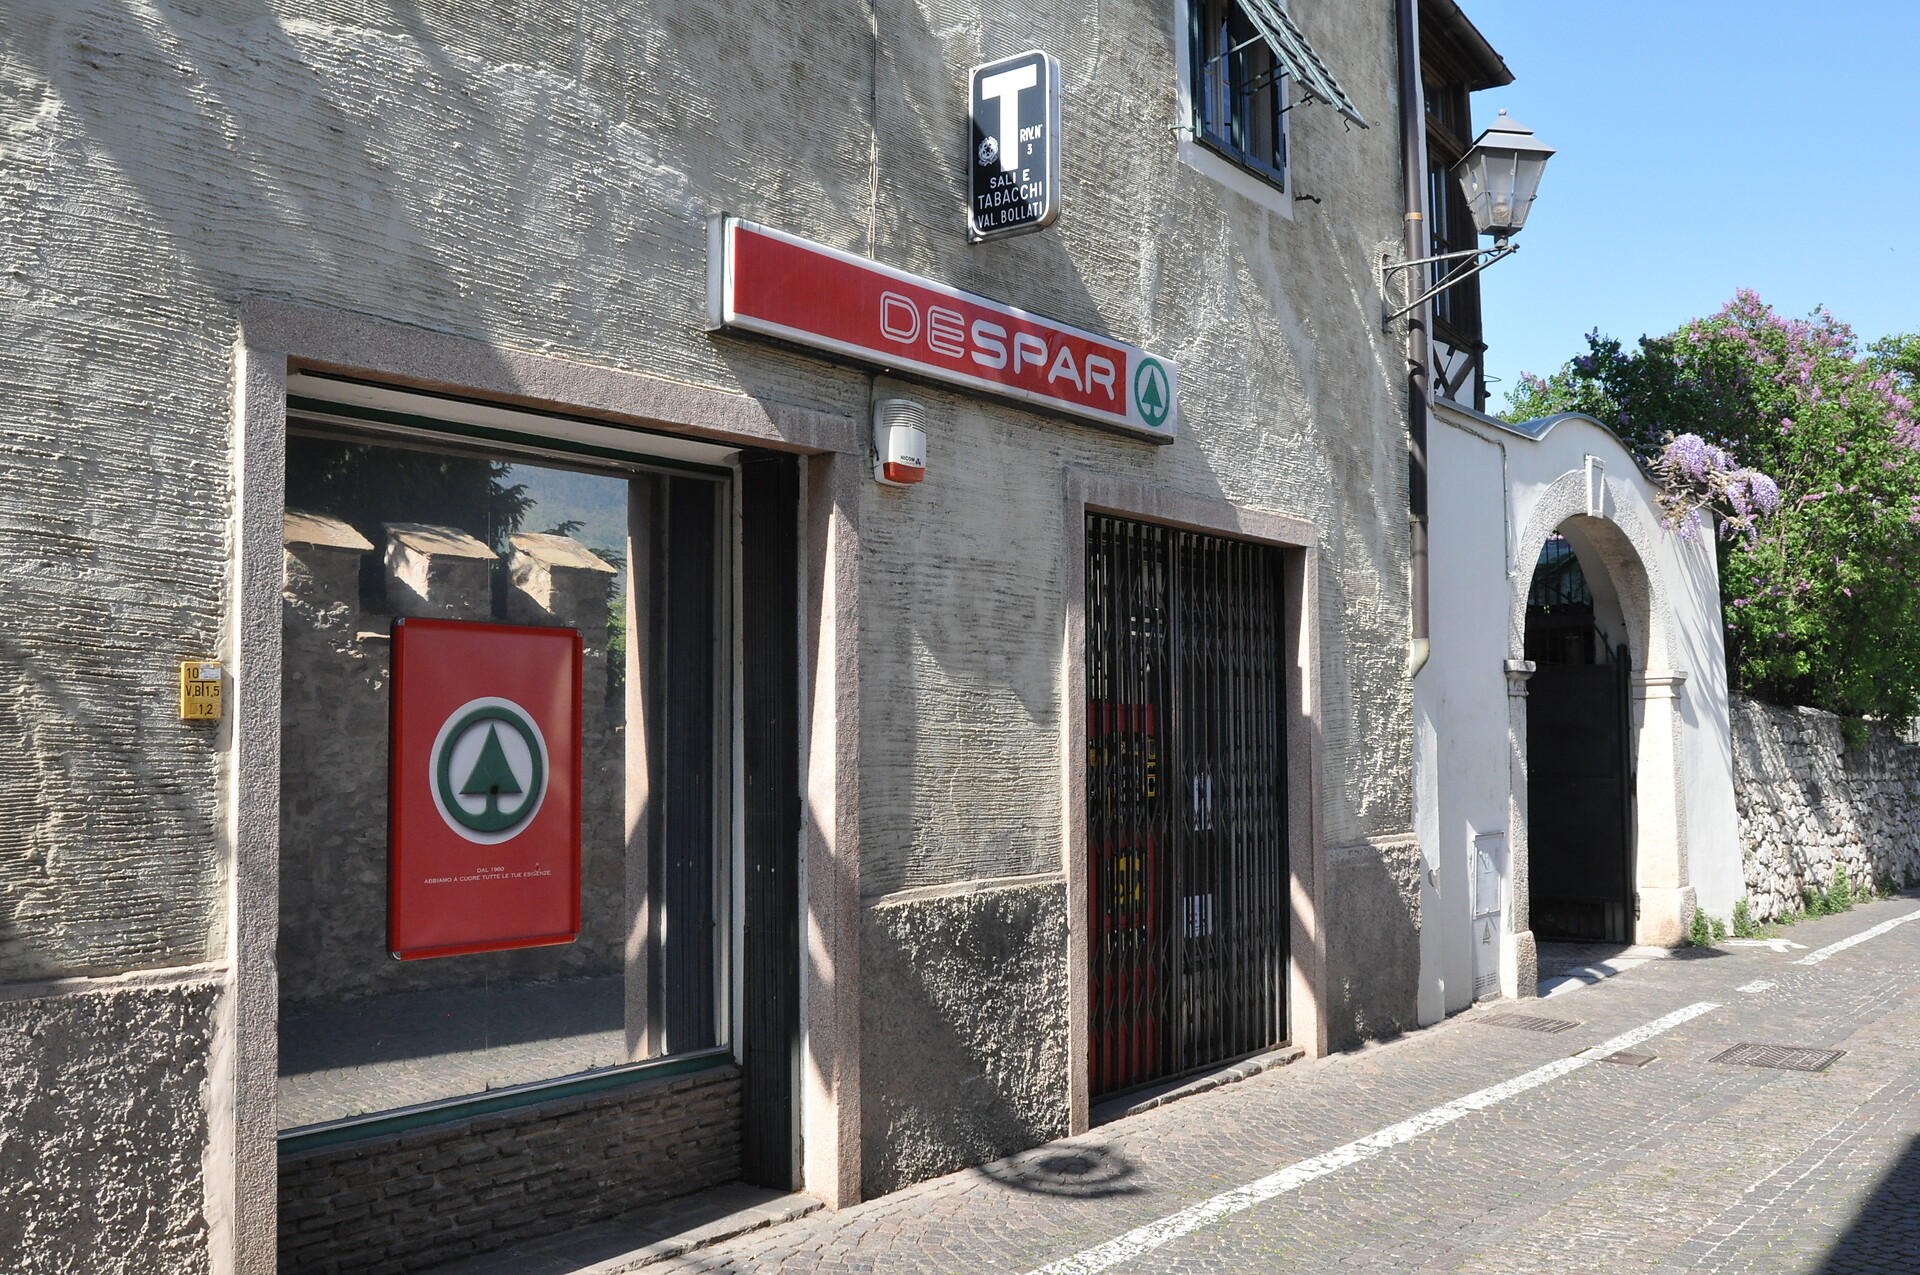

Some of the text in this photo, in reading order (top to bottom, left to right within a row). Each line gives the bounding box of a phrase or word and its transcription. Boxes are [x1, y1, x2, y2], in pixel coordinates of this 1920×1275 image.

[982, 64, 1037, 172] T
[1027, 143, 1032, 155] 3
[989, 168, 1031, 189] SALI E
[977, 181, 1042, 211] TABACCHI
[977, 201, 1043, 229] VAL. BOLLATI
[879, 291, 1115, 400] DESPAR
[186, 667, 199, 679] 10
[424, 876, 452, 884] ABBIAMO
